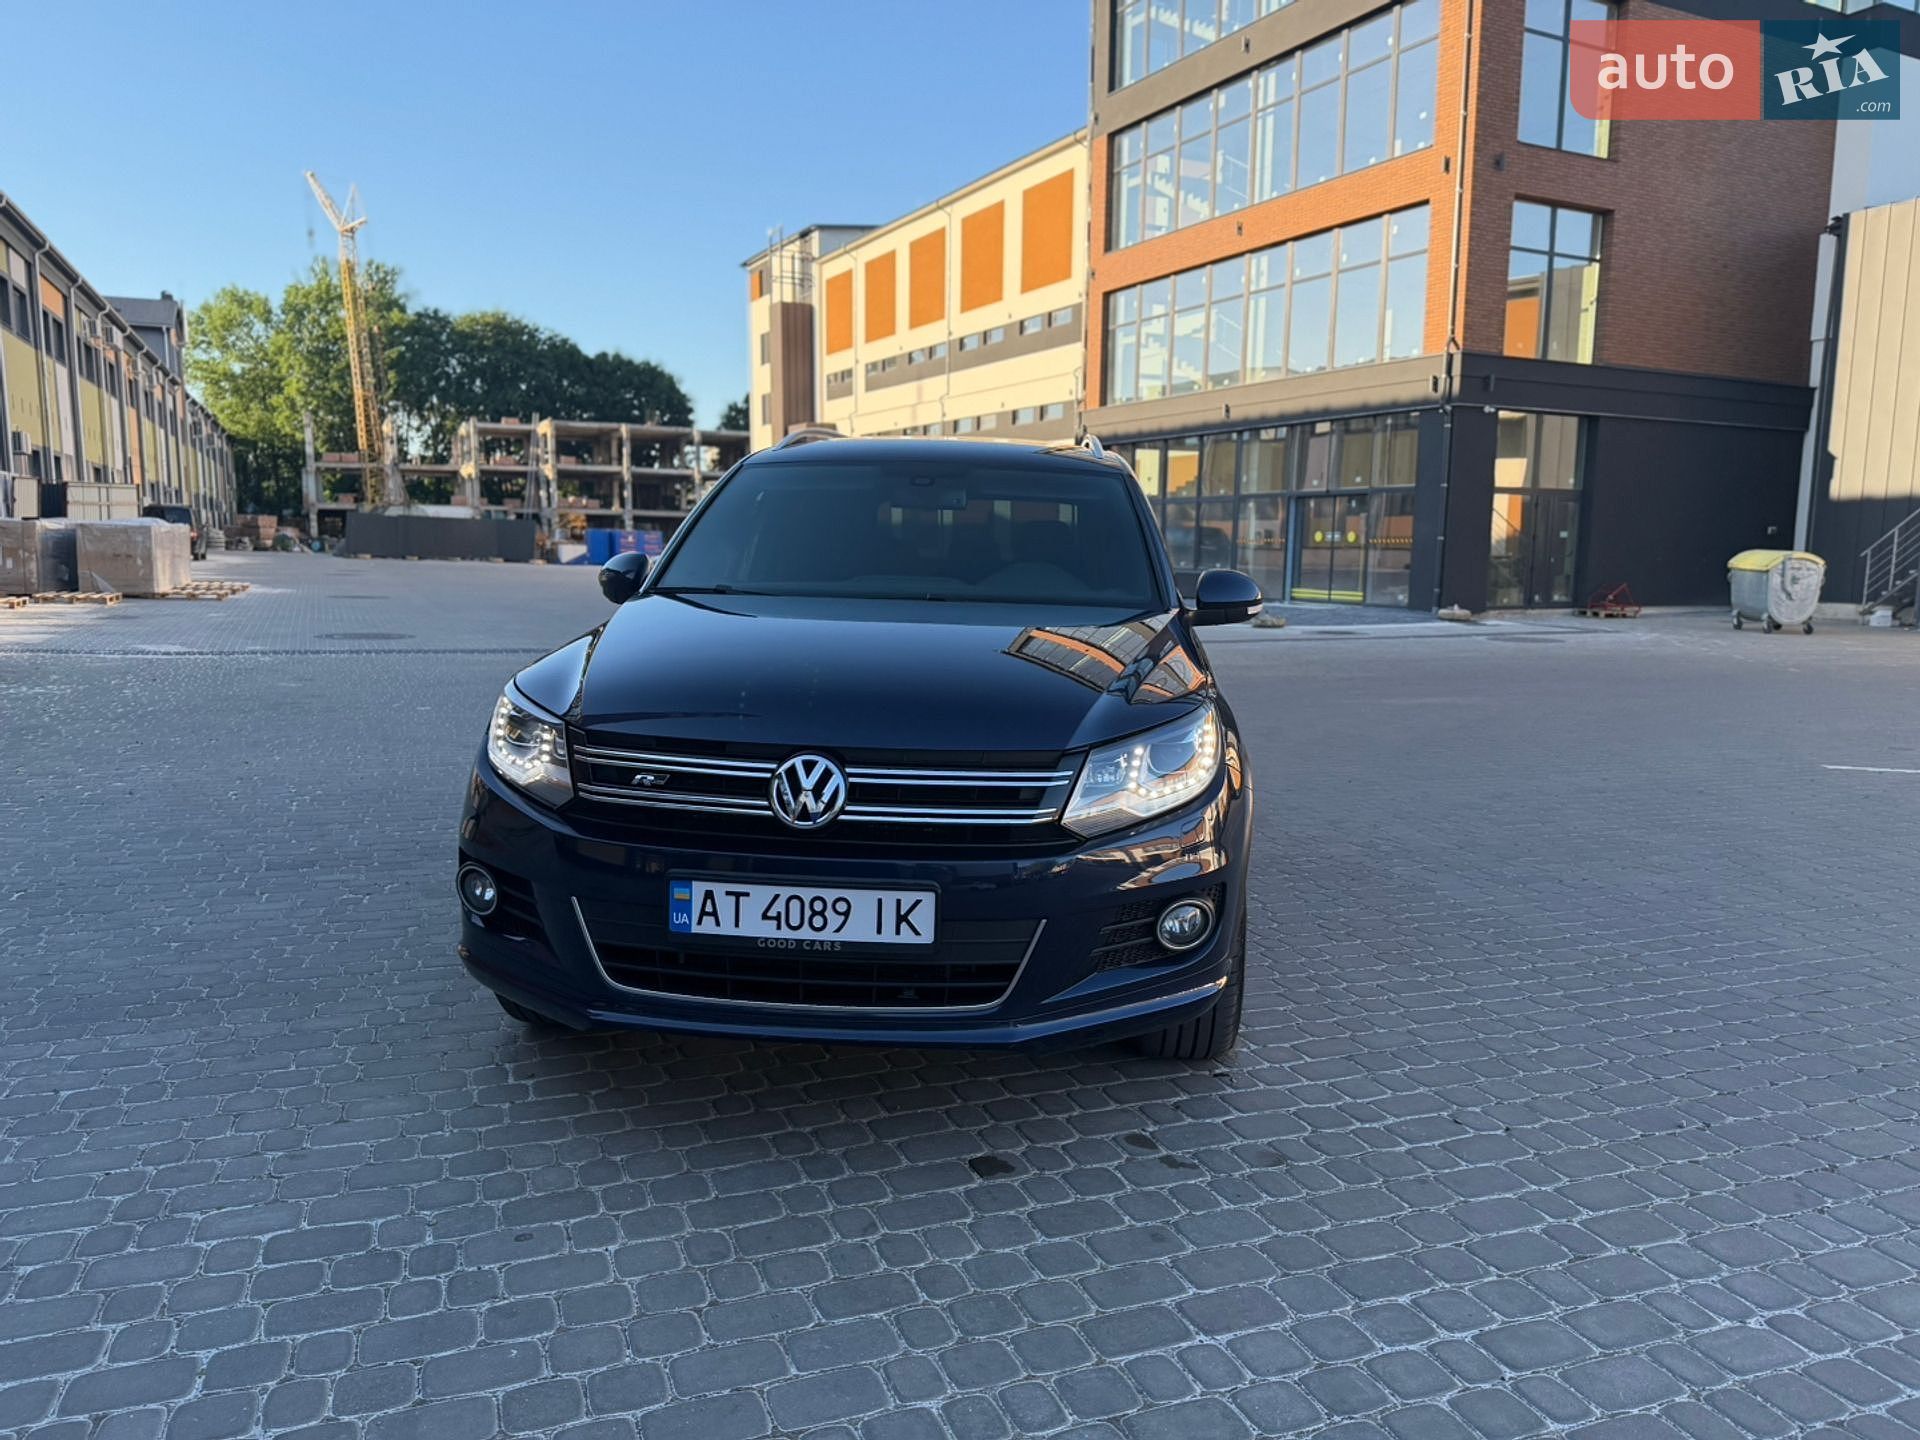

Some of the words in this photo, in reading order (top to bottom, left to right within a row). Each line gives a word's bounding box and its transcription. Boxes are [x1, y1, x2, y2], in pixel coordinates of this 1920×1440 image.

[772, 753, 845, 827] VW
[673, 912, 690, 925] UA
[696, 889, 750, 928] AT
[761, 893, 852, 934] 4089
[875, 897, 923, 936] IK
[757, 937, 797, 950] GOOD
[803, 939, 842, 952] CARS
